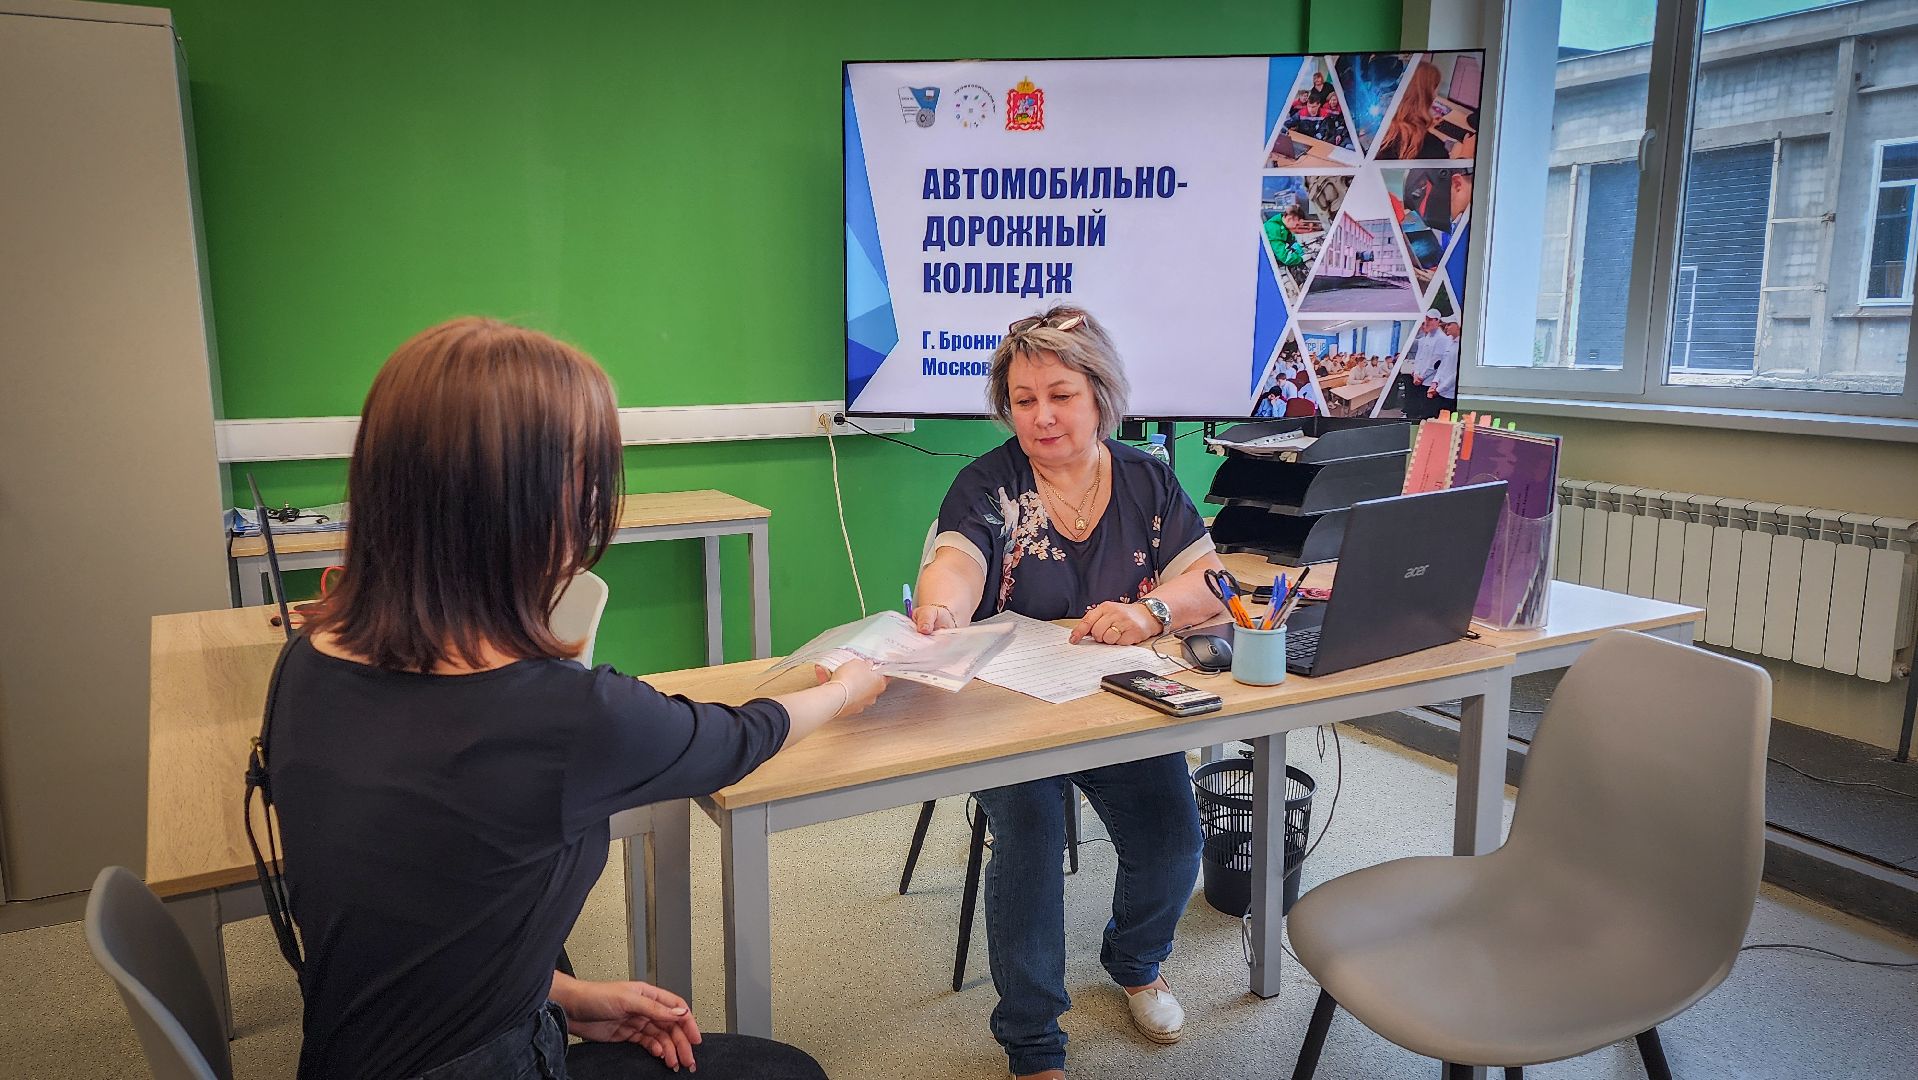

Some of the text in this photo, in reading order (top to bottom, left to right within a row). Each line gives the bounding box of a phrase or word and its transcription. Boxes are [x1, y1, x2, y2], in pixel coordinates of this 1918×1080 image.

[922, 165, 1188, 200] АВТОМОБИЛЬНО-
[922, 208, 1107, 252] ДОРОЖНЫЙ
[922, 262, 1073, 299] КОЛЛЕДЖ
[922, 330, 936, 350] Г.
[1404, 564, 1430, 579] acer
